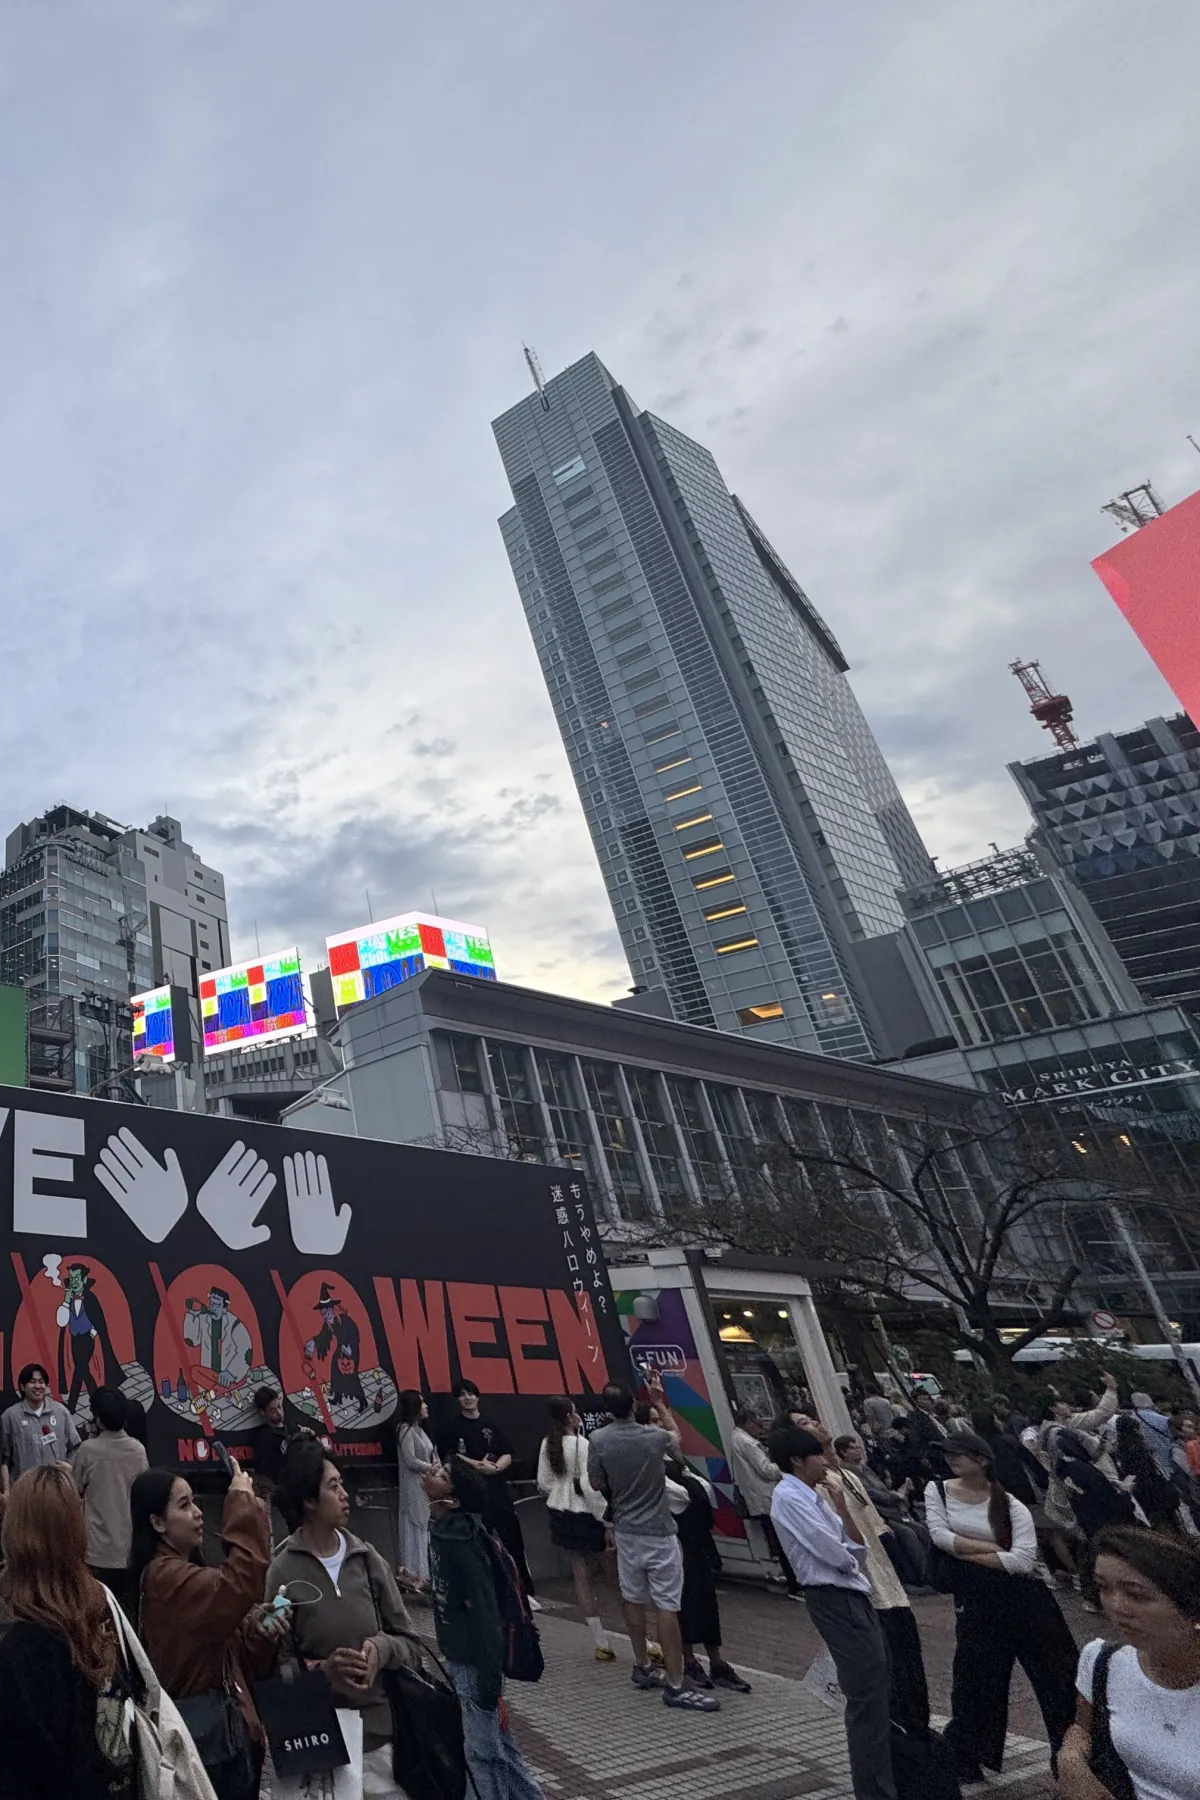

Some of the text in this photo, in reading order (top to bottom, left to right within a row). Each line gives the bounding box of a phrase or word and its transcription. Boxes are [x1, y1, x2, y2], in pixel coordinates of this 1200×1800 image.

[388, 924, 418, 941] YES
[1000, 1060, 1195, 1103] MARK CITY
[1040, 1060, 1132, 1082] SHIBUYA
[569, 1182, 607, 1314] もうやめよ？
[550, 1184, 599, 1364] 迷惑ハロウィーン
[284, 1733, 329, 1751] SHIRO
